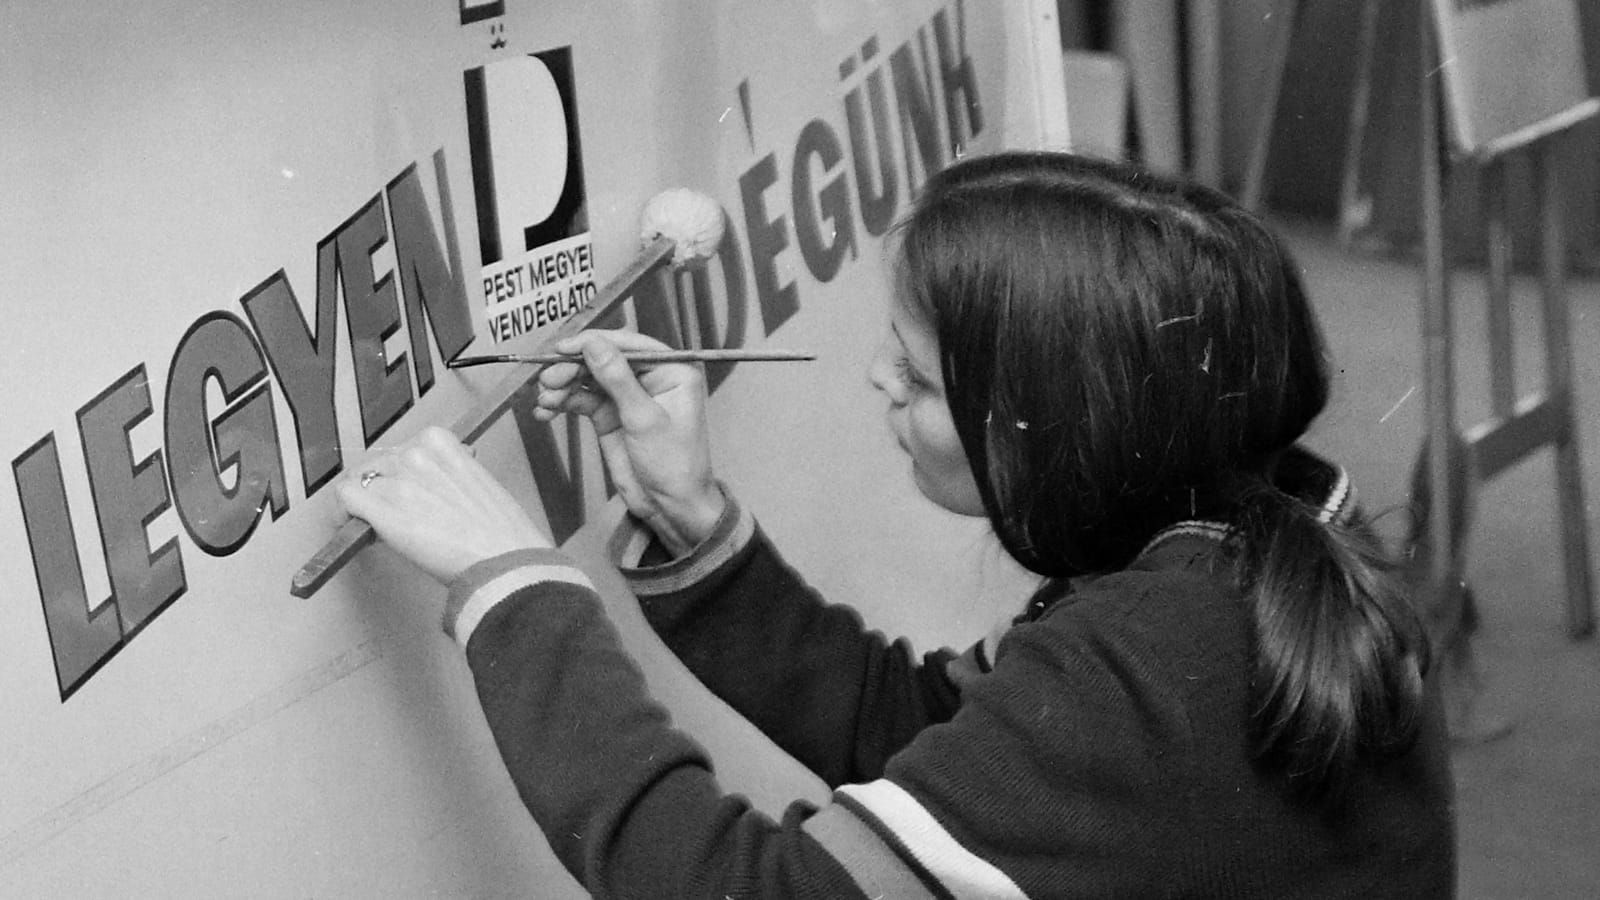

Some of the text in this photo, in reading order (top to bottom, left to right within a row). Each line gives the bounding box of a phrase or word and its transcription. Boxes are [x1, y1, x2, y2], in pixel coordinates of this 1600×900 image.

[12, 147, 475, 703] LEGYEN
[483, 243, 594, 306] PEST MEGYEI
[488, 272, 597, 344] VENDÉGLÁTÓ
[511, 0, 984, 548] VDÉGÜNK
